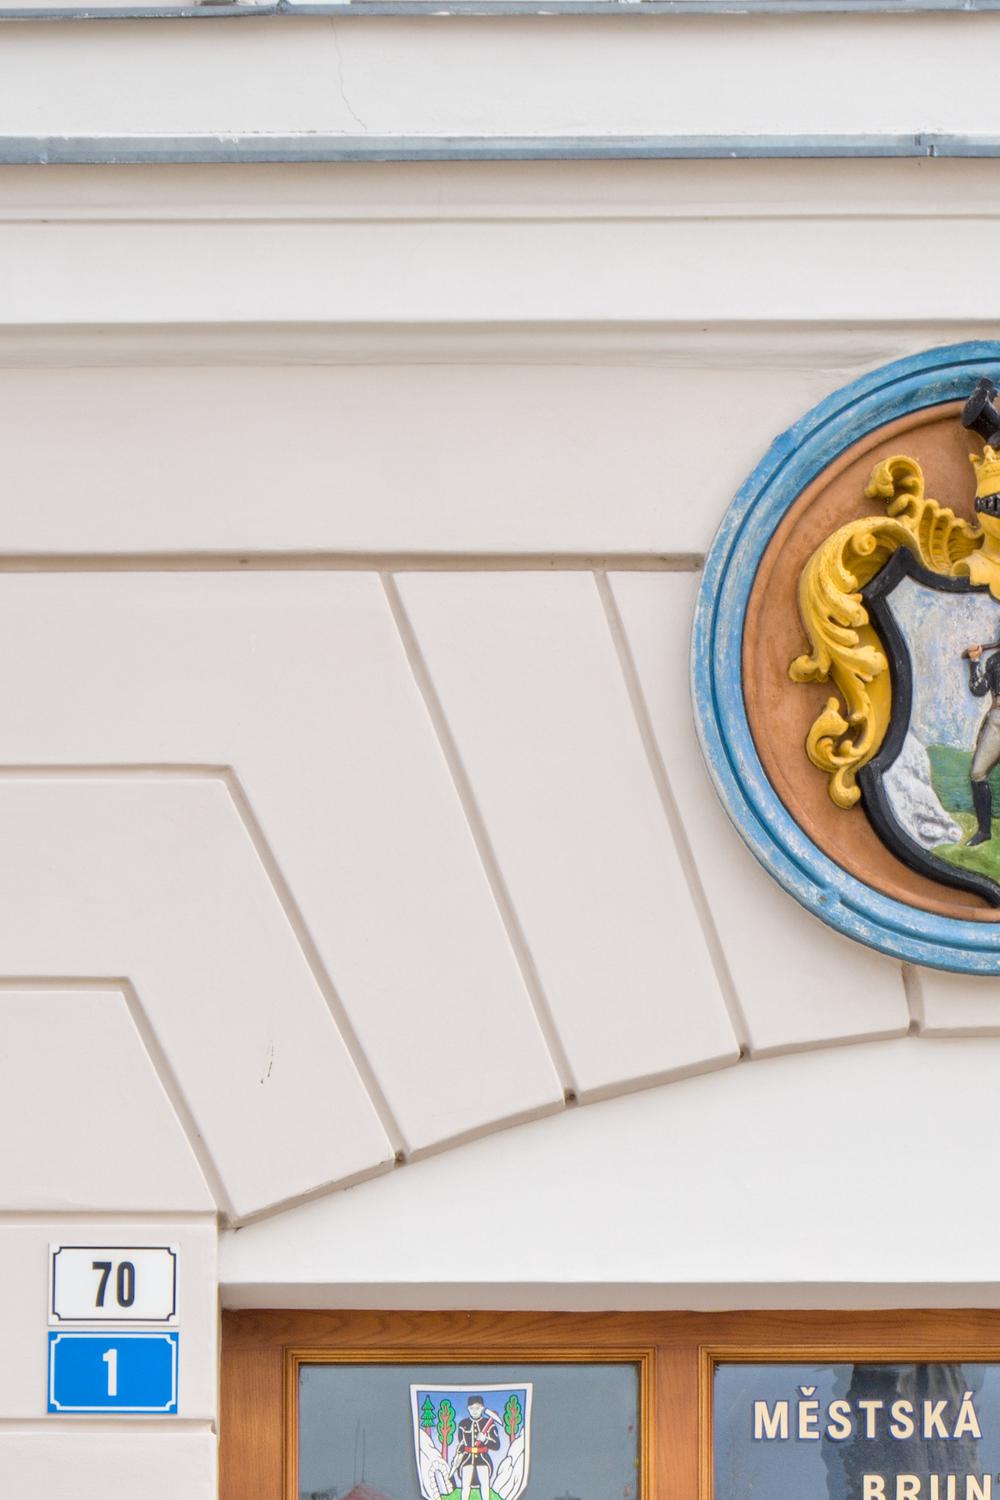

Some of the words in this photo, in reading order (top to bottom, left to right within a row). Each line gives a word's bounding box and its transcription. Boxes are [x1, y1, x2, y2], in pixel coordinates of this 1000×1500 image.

[92, 1261, 136, 1308] 70
[102, 1348, 118, 1396] 1
[752, 1386, 982, 1440] MĚSTSKÁ
